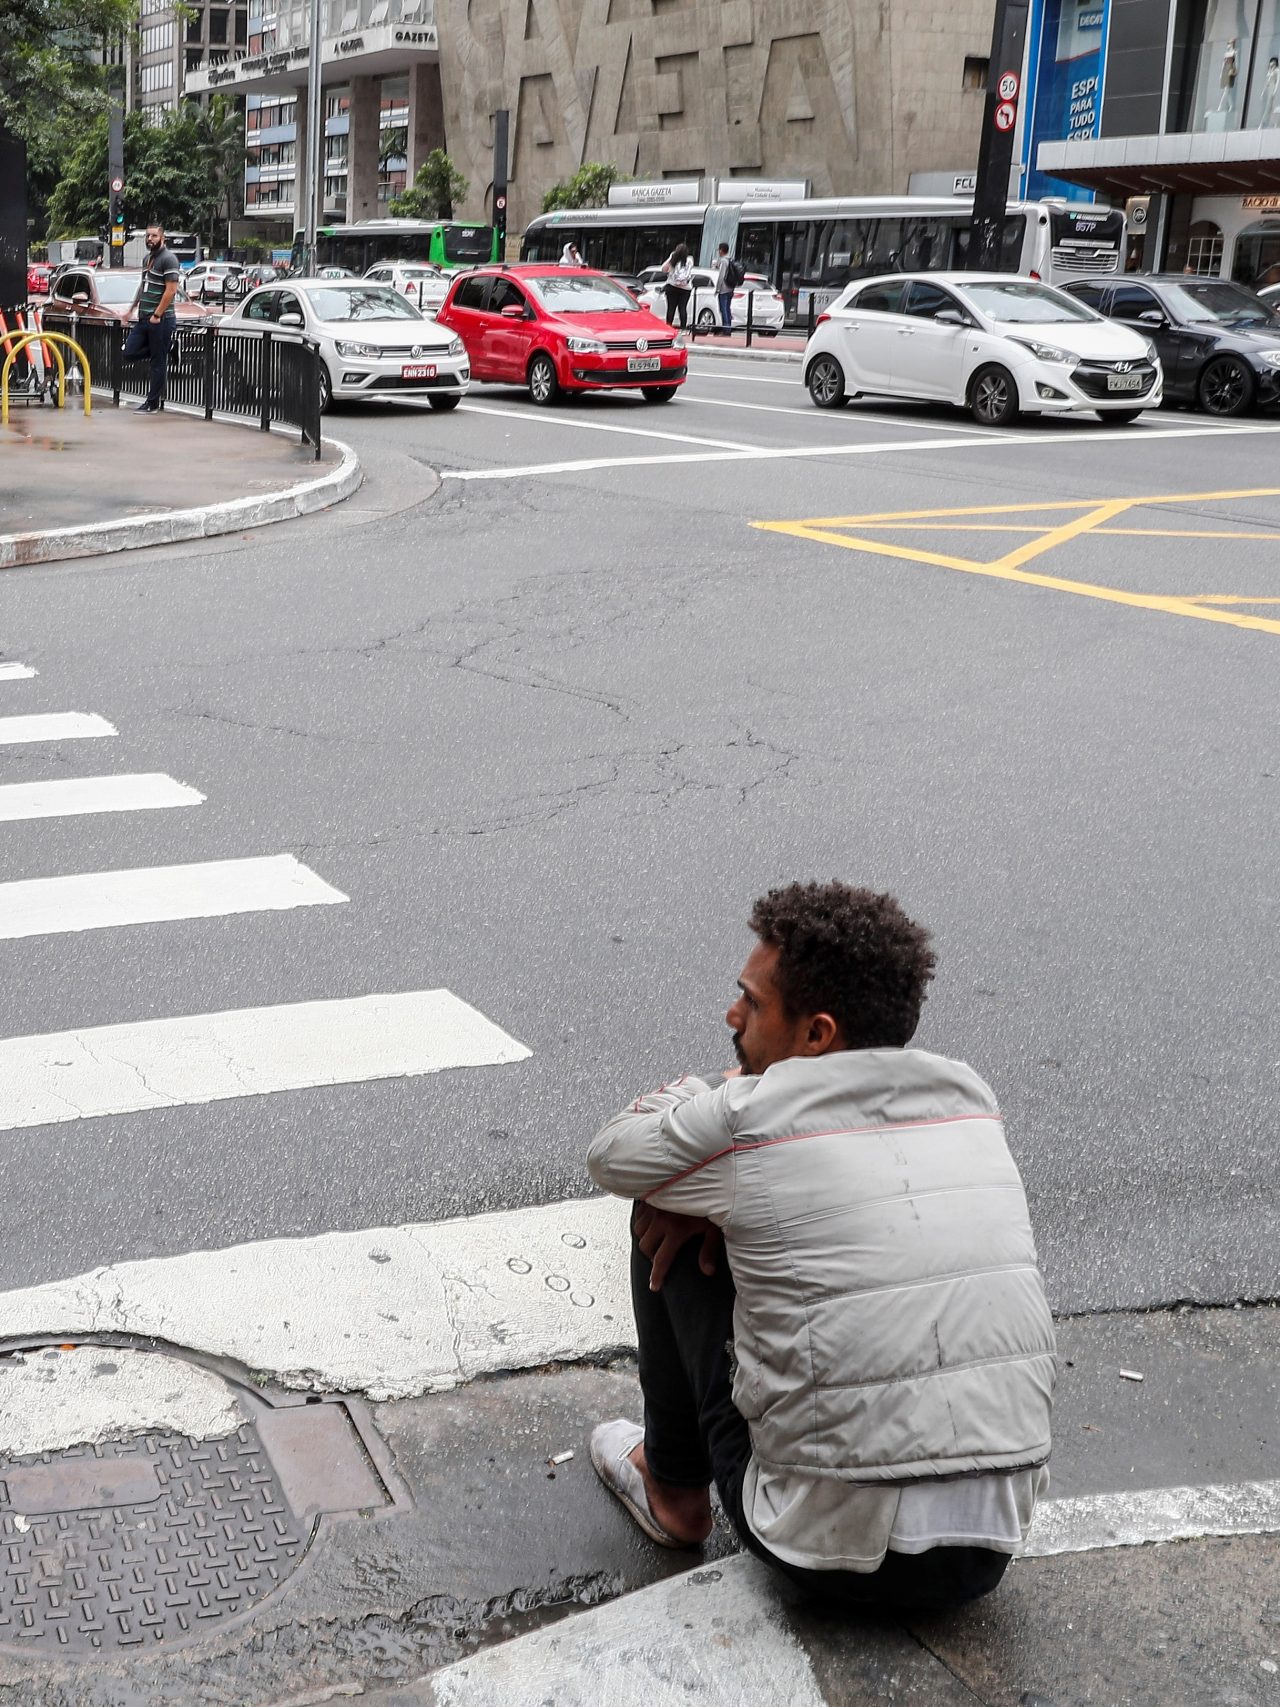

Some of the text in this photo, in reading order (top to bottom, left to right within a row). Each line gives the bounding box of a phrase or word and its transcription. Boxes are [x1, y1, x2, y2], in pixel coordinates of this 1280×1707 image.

[395, 31, 436, 43] GAZETA
[1002, 80, 1015, 92] 50
[1069, 99, 1092, 115] PARA
[1069, 111, 1095, 130] TUDO
[955, 178, 974, 189] FCL
[631, 187, 672, 197] BANCA GAZETA
[325, 271, 341, 279] TAXI
